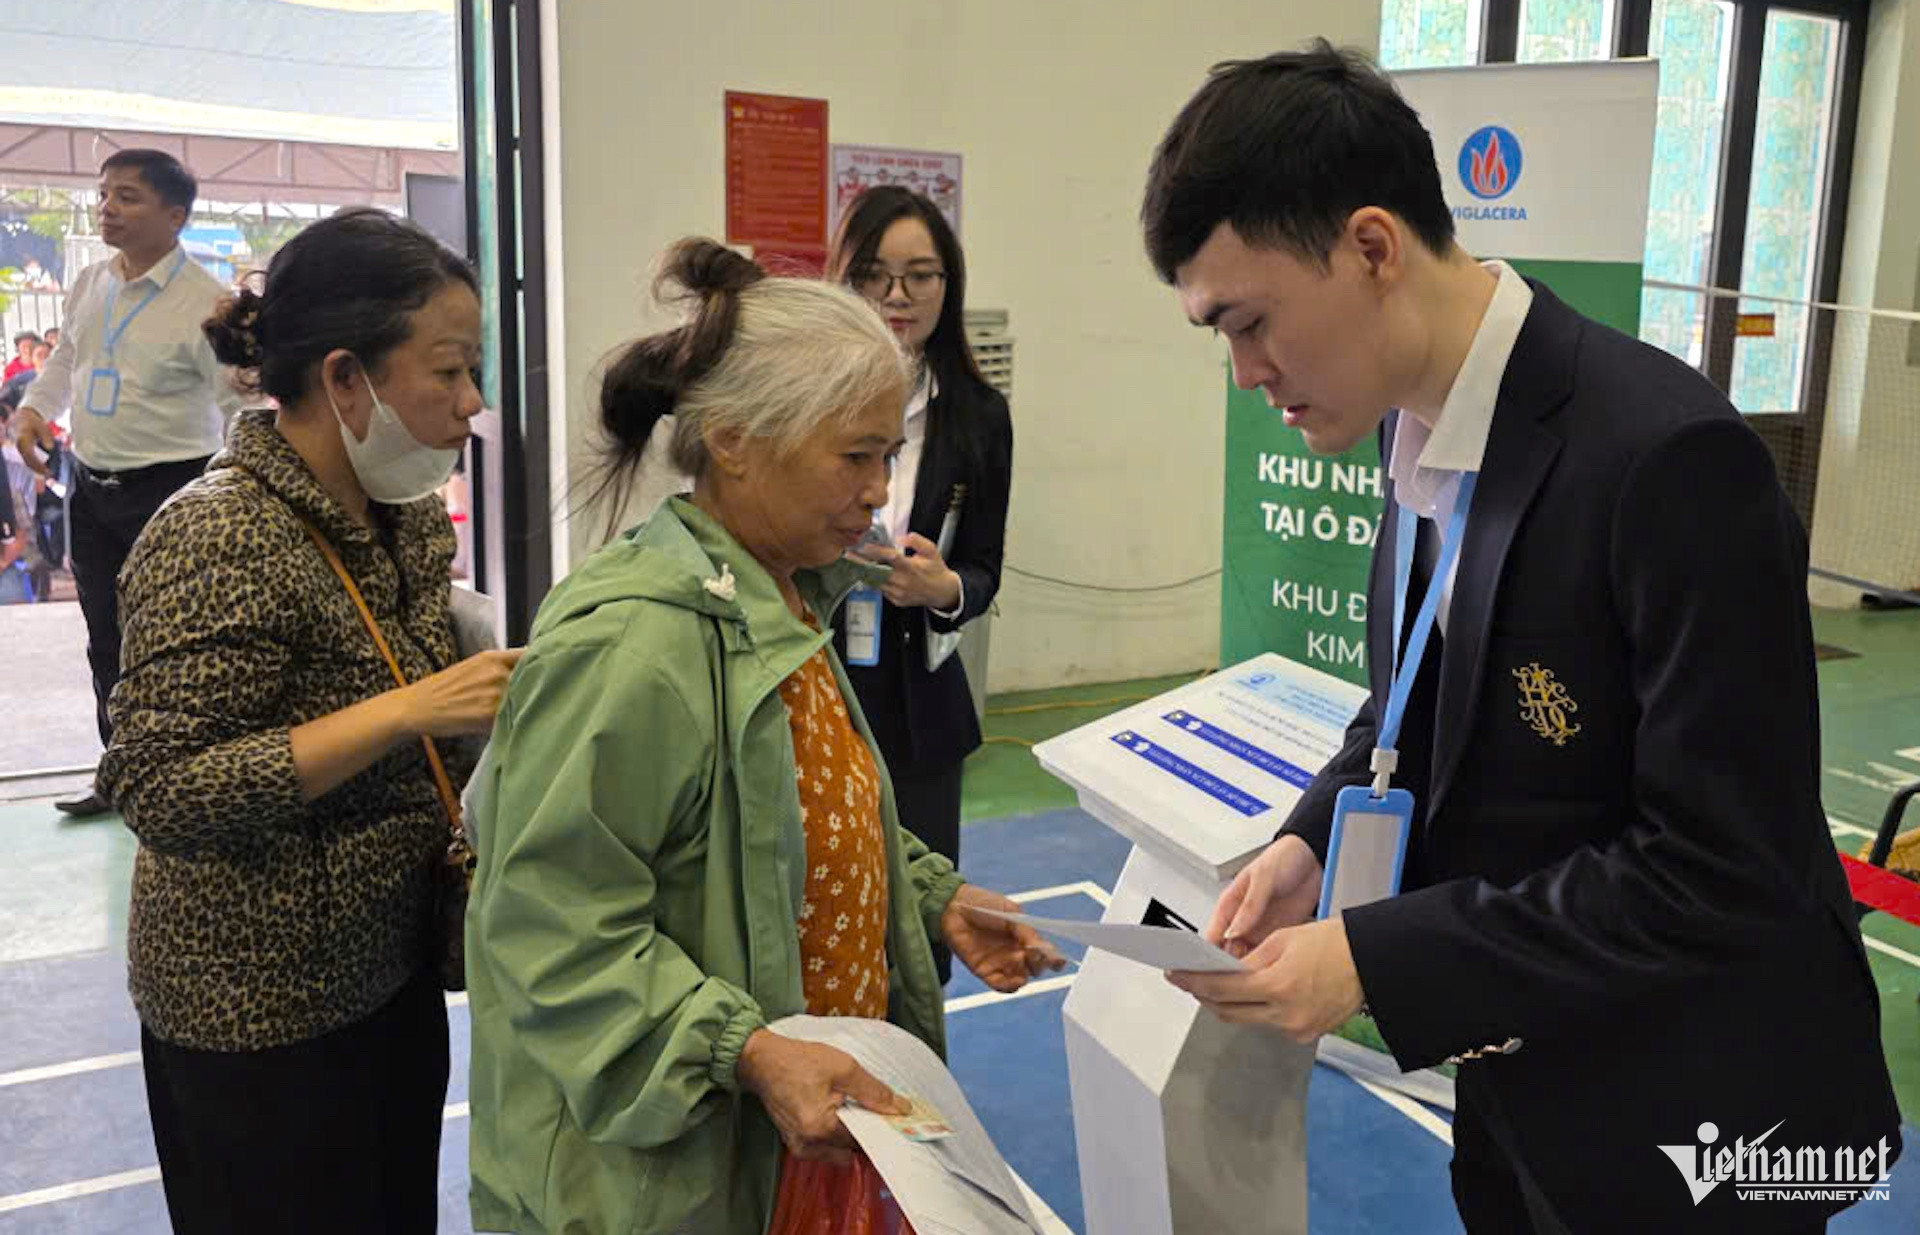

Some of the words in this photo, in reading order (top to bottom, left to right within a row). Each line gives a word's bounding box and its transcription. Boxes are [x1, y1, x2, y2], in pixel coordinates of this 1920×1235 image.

[1258, 451, 1323, 489] KHU
[1330, 462, 1385, 499] NH
[1260, 500, 1305, 541] TẠI
[1312, 504, 1340, 541] Ô
[1272, 577, 1339, 617] KHU
[1306, 630, 1364, 669] KIM
